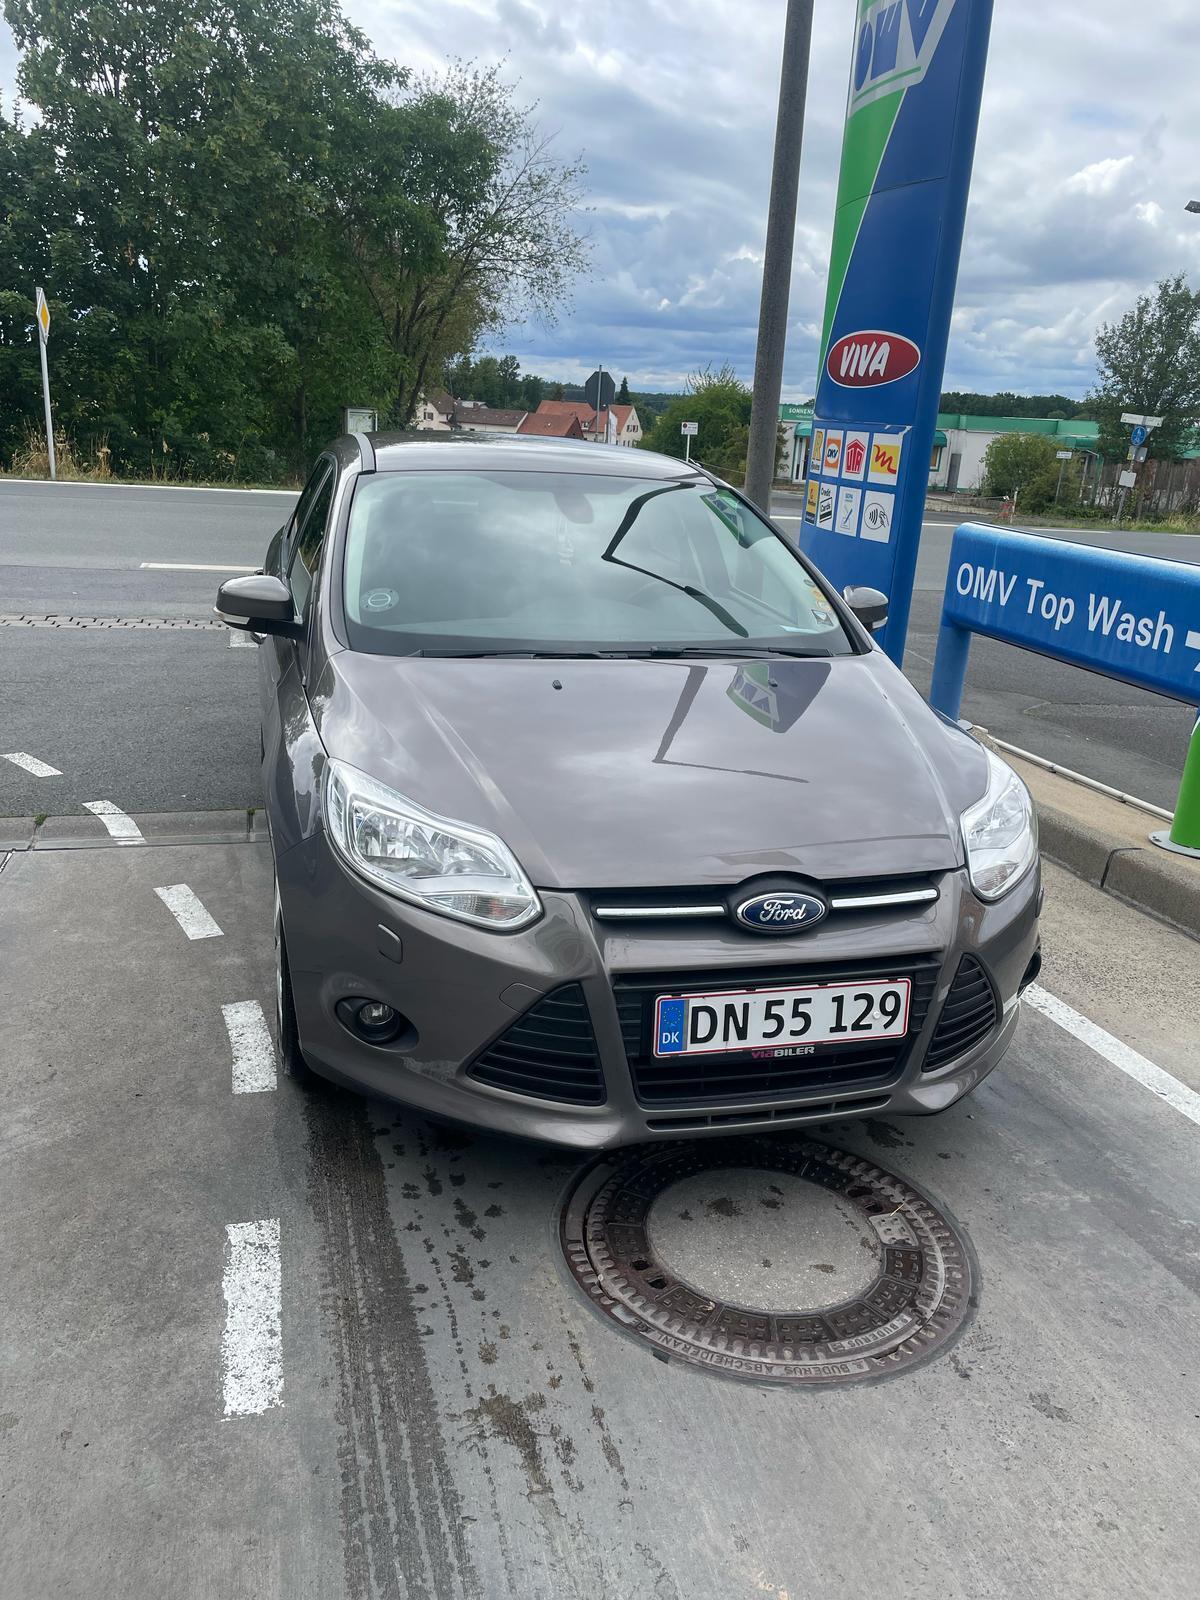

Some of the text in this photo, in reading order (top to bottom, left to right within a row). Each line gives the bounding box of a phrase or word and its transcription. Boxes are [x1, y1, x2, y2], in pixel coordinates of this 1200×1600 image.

[840, 341, 890, 378] VIVA
[827, 448, 839, 459] DKV
[821, 487, 831, 497] Credit
[956, 562, 1174, 654] OMV Top Wash
[759, 899, 807, 922] Ford
[689, 990, 902, 1045] DN 55 129
[662, 1031, 680, 1044] DK
[846, 1322, 899, 1348] BUDERUS
[784, 1363, 850, 1377] BUDERUS
